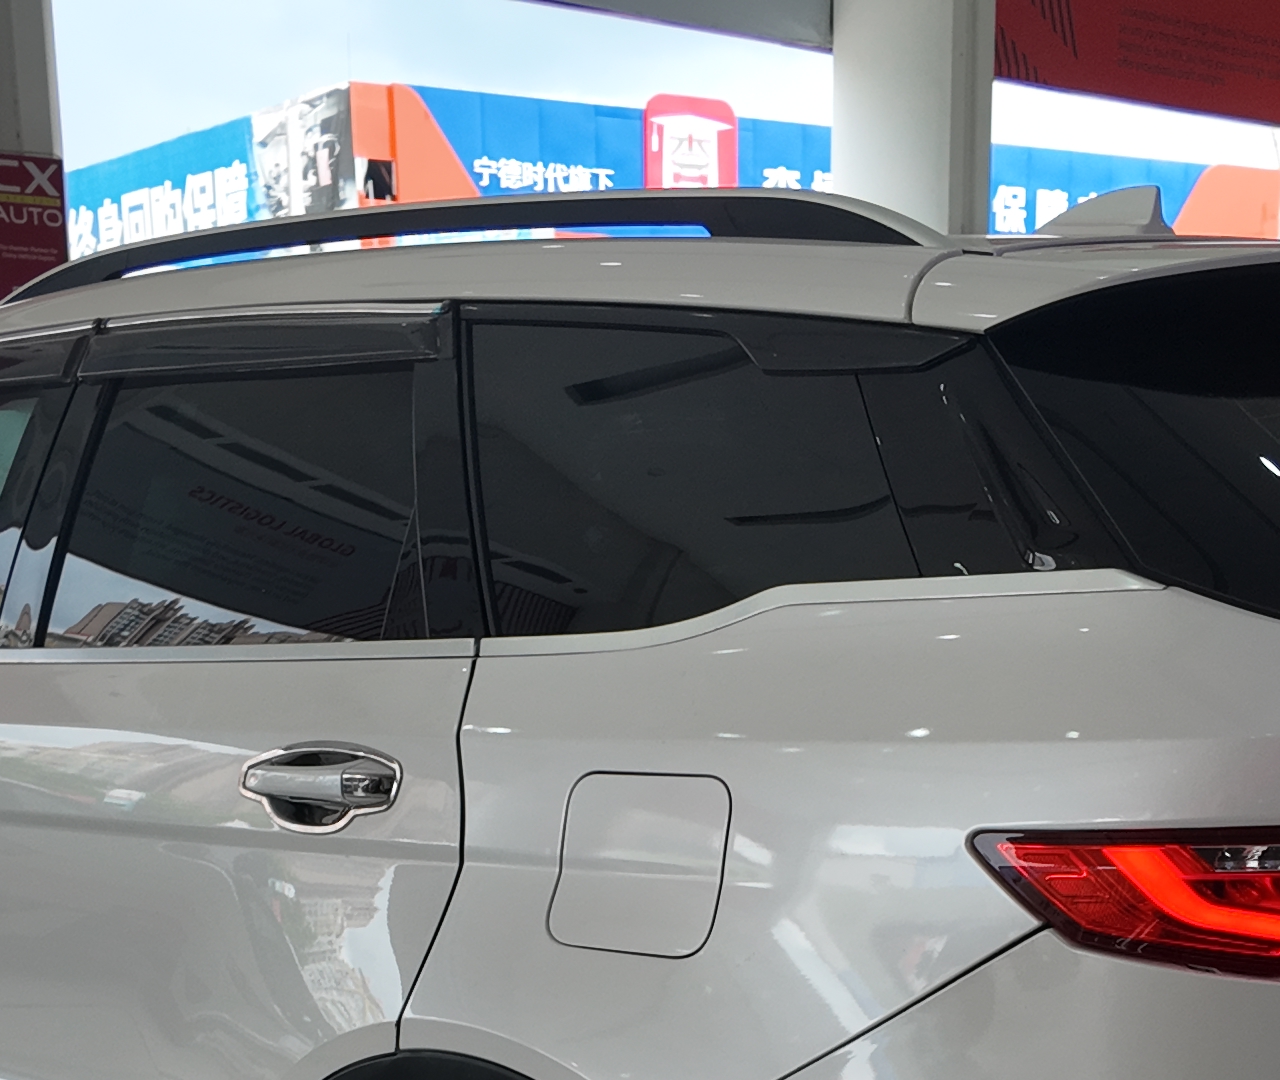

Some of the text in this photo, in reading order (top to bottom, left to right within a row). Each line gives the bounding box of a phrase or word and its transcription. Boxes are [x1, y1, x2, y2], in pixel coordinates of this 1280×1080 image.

[473, 155, 615, 193] 宁德时代旗下
[68, 159, 249, 260] 终身回购保障
